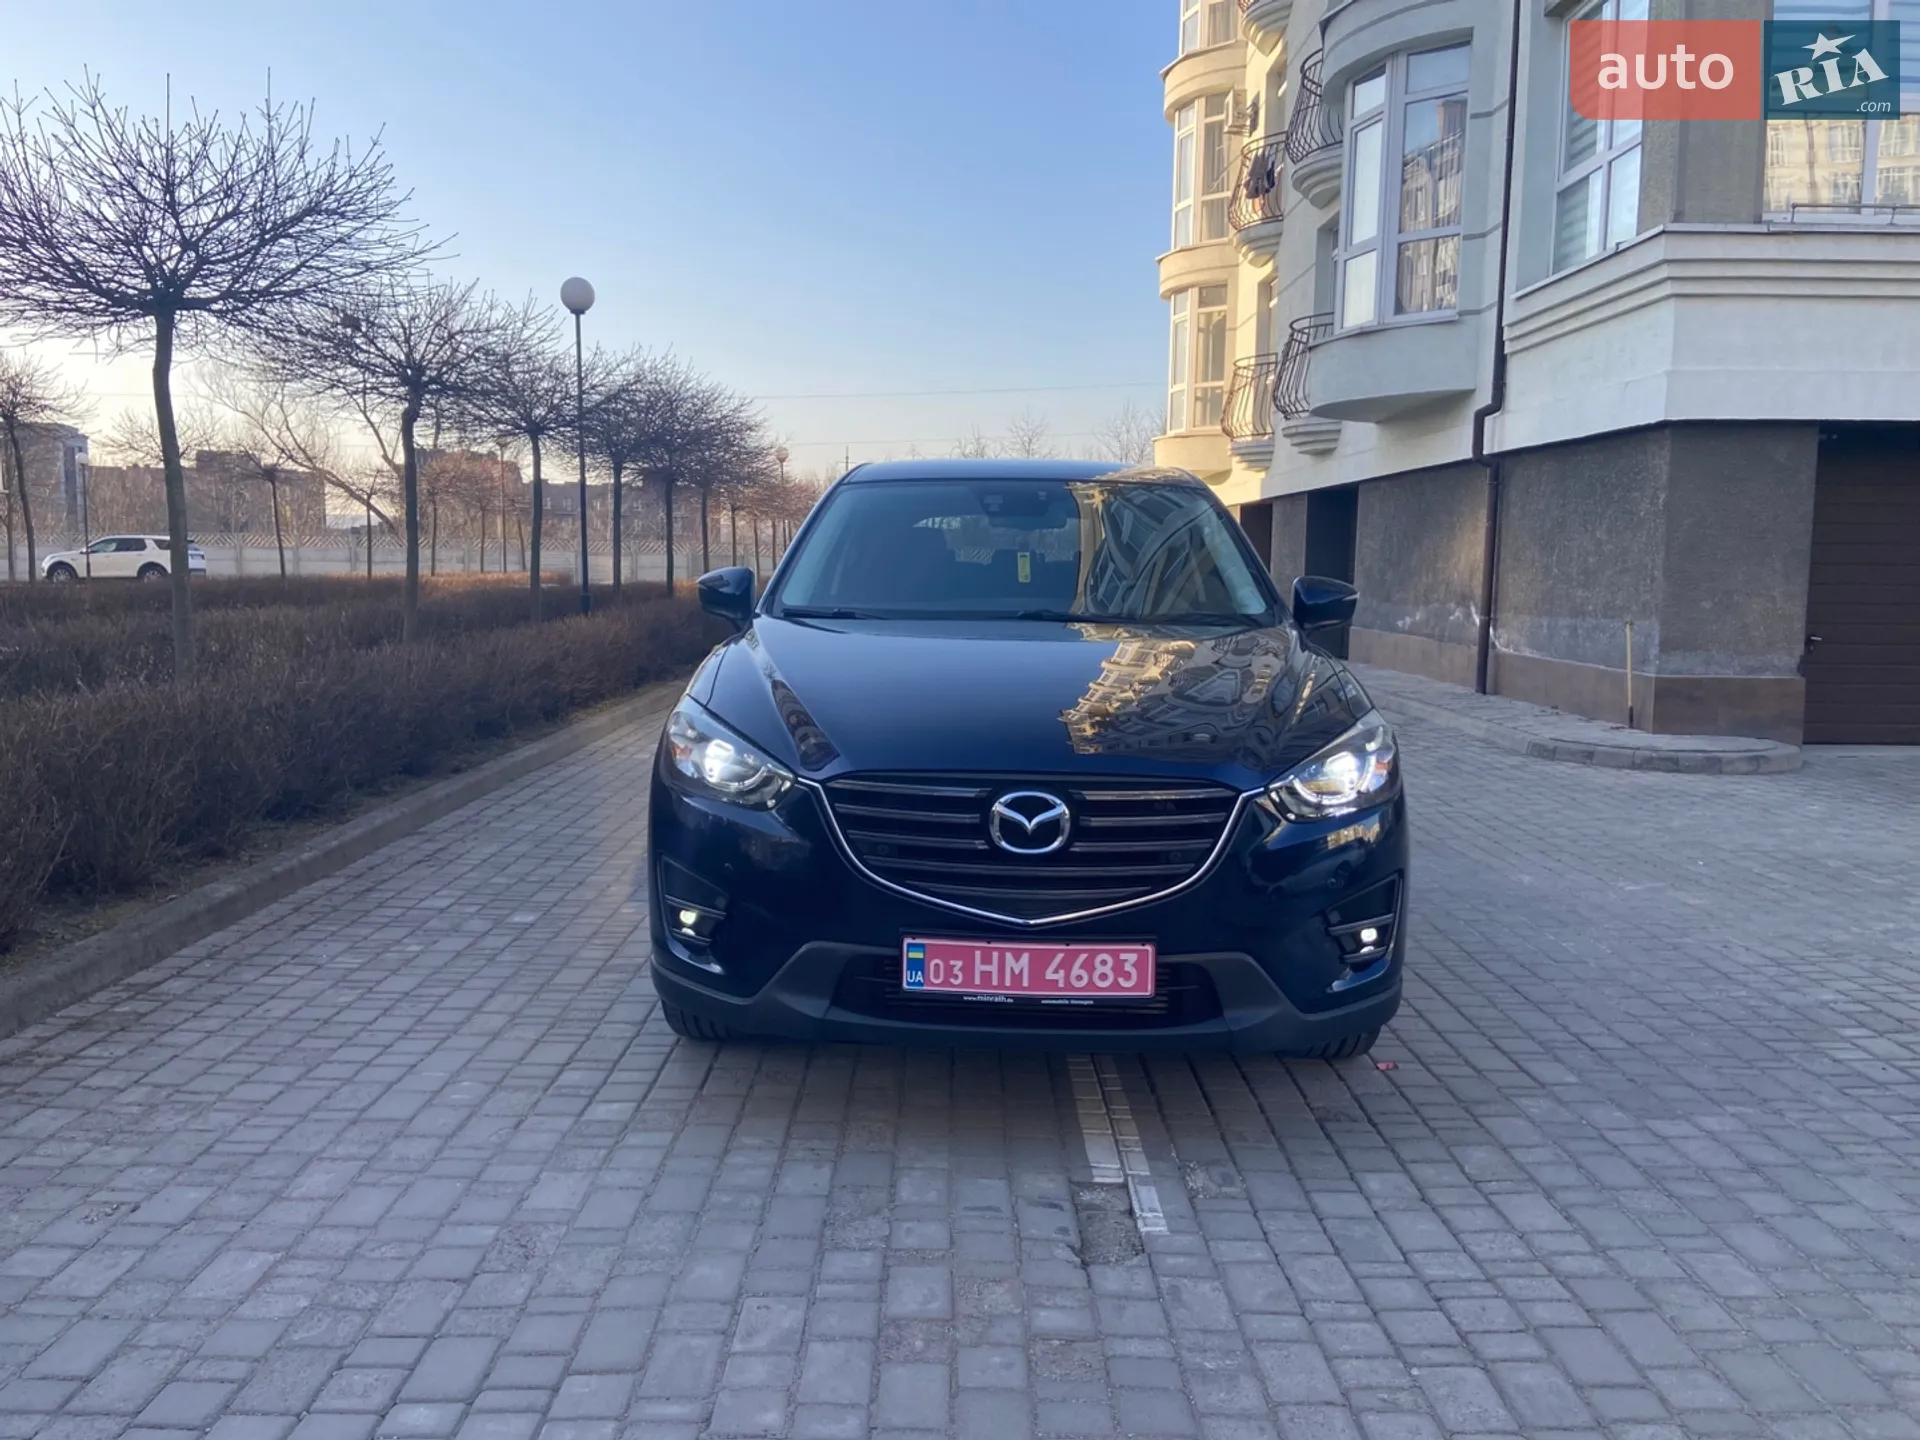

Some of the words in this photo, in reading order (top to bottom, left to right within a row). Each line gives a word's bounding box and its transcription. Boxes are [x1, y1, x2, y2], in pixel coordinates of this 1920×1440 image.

[907, 970, 923, 983] UA
[929, 958, 963, 985] 03
[974, 950, 1030, 987] HM
[1045, 953, 1138, 988] 4683
